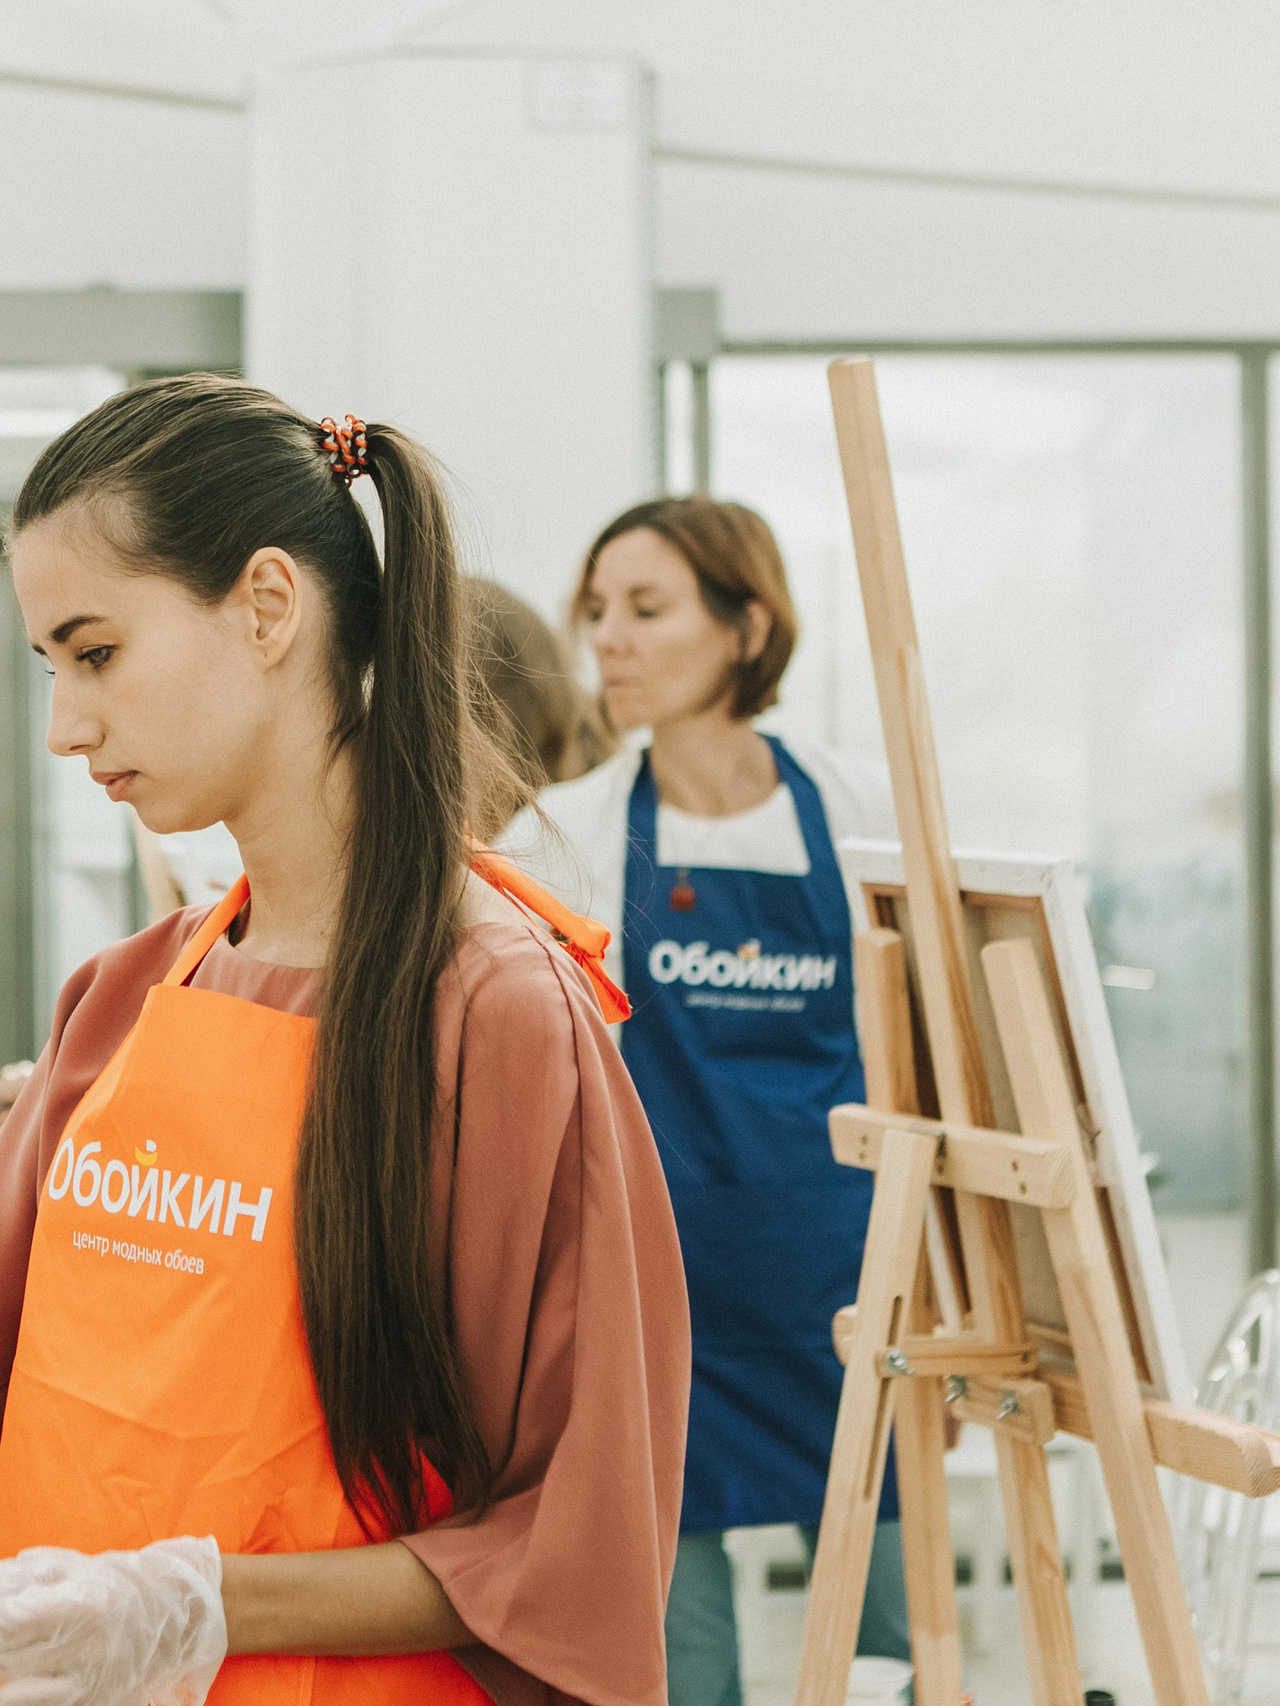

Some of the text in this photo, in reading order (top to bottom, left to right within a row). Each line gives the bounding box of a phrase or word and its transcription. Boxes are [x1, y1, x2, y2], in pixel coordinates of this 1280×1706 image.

[648, 937, 838, 991] Обойкин
[48, 1136, 274, 1242] Обойкин
[72, 1230, 205, 1275] центр модных обоев
